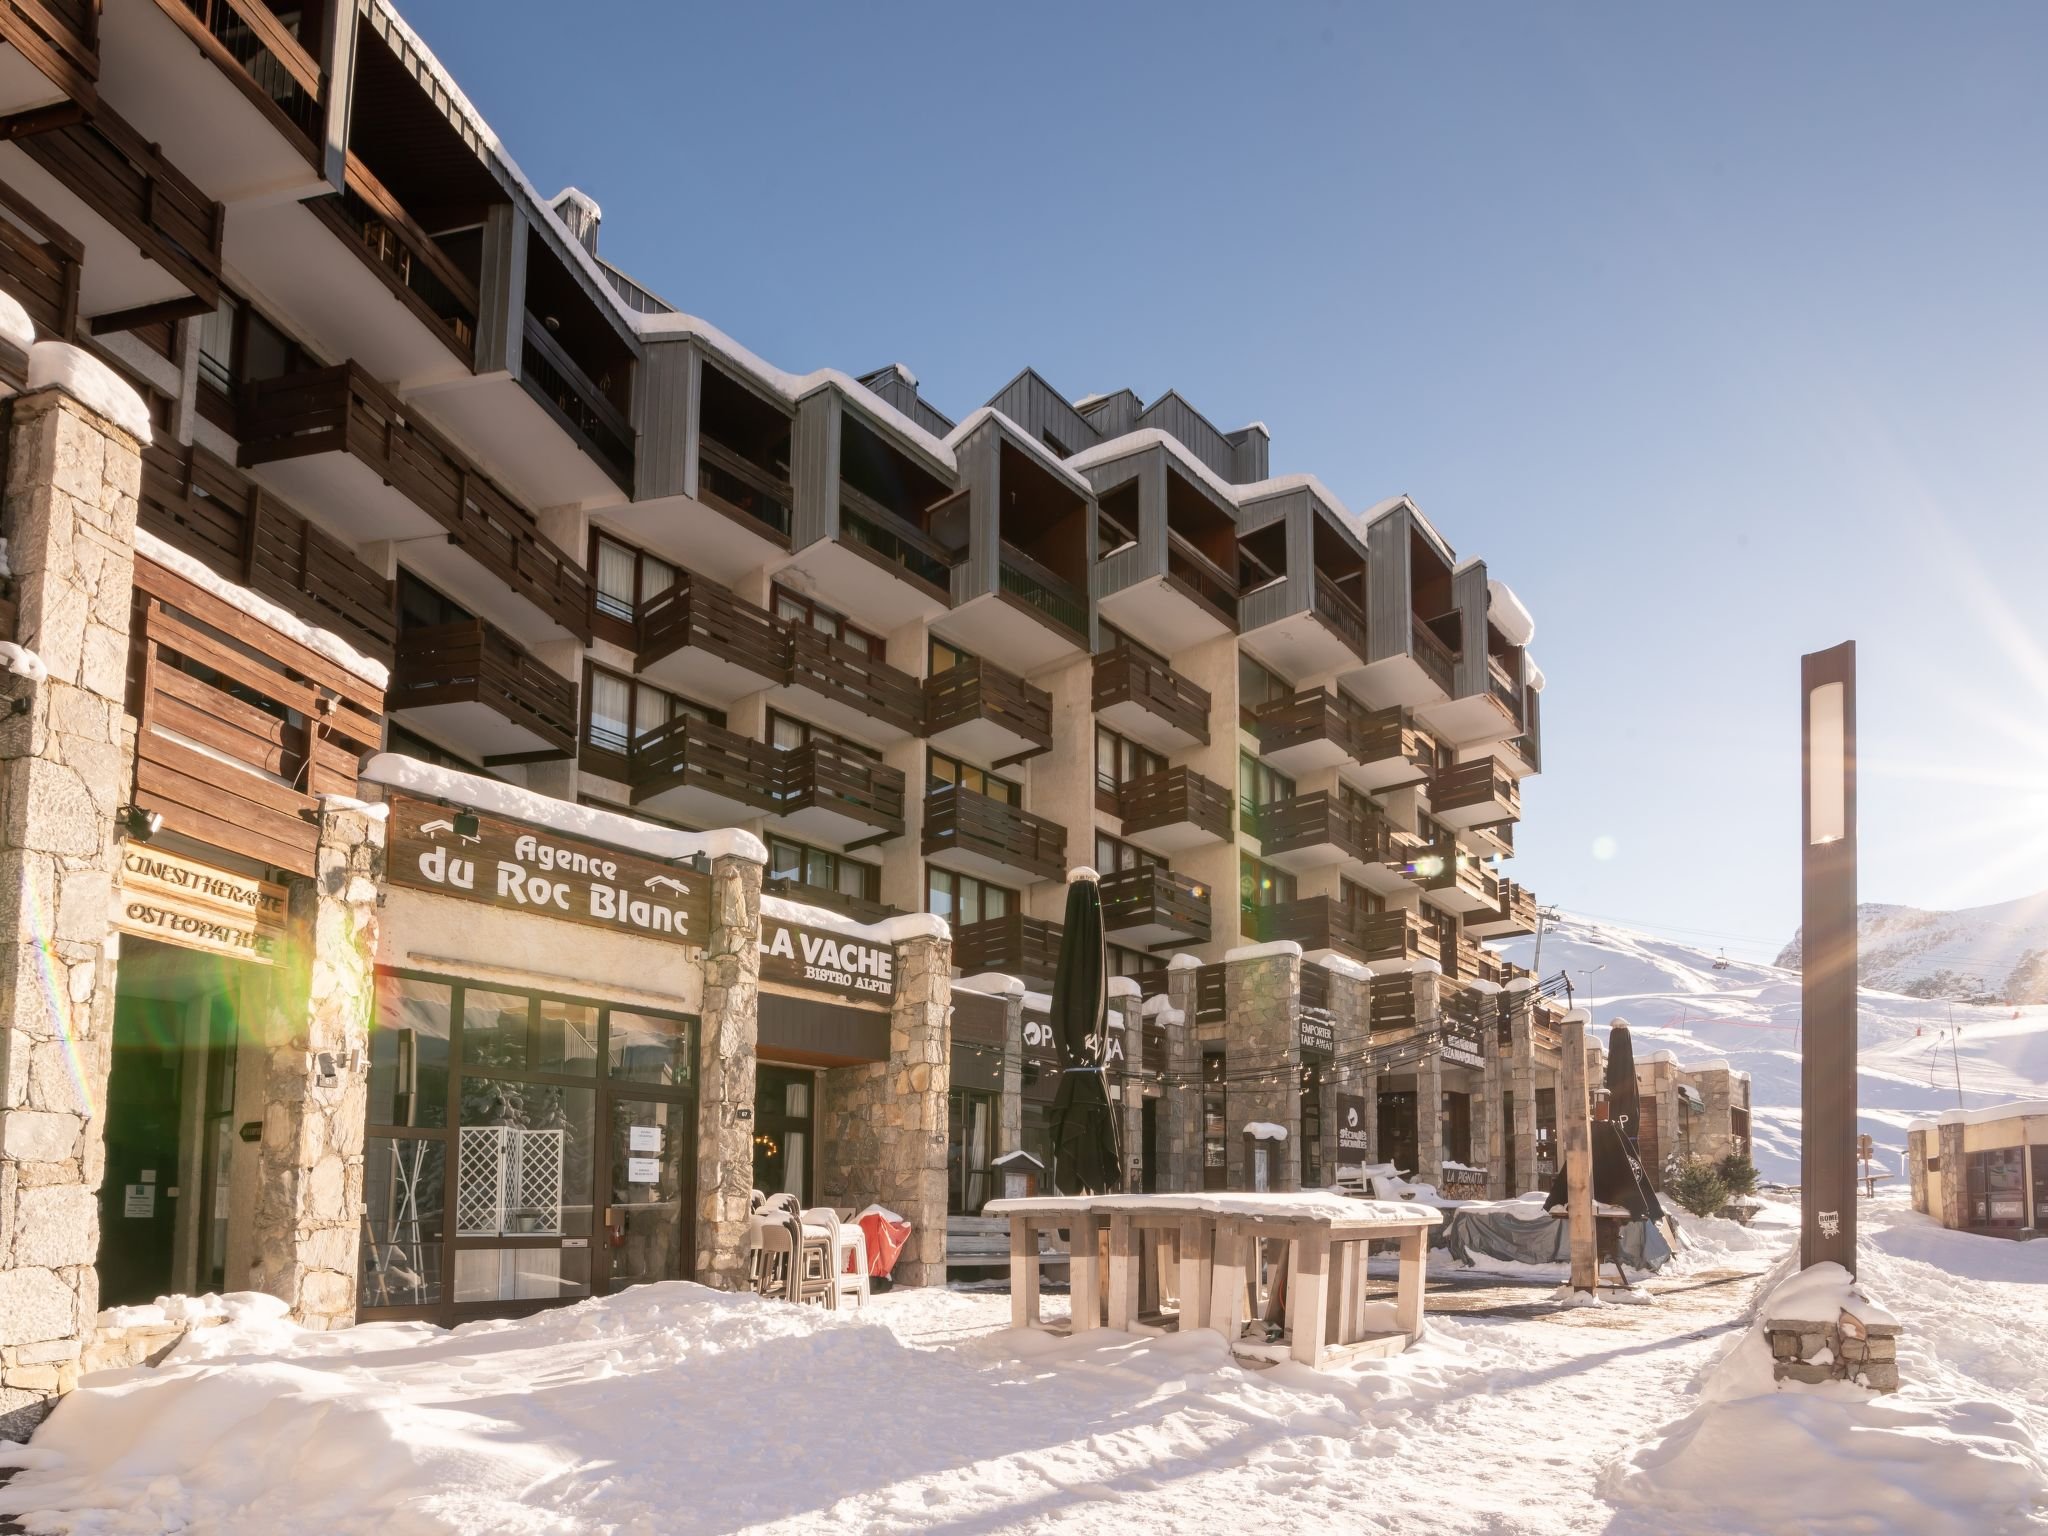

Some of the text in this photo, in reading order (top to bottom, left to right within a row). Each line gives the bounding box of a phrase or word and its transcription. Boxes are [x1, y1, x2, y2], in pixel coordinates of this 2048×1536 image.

[514, 834, 617, 881] Agence
[418, 845, 689, 936] du Roc Blanc
[799, 932, 893, 981] VACHE
[803, 965, 893, 995] BISTRO ALPIN
[1301, 1022, 1332, 1040] EMPORTER
[1301, 1034, 1315, 1046] TAKE
